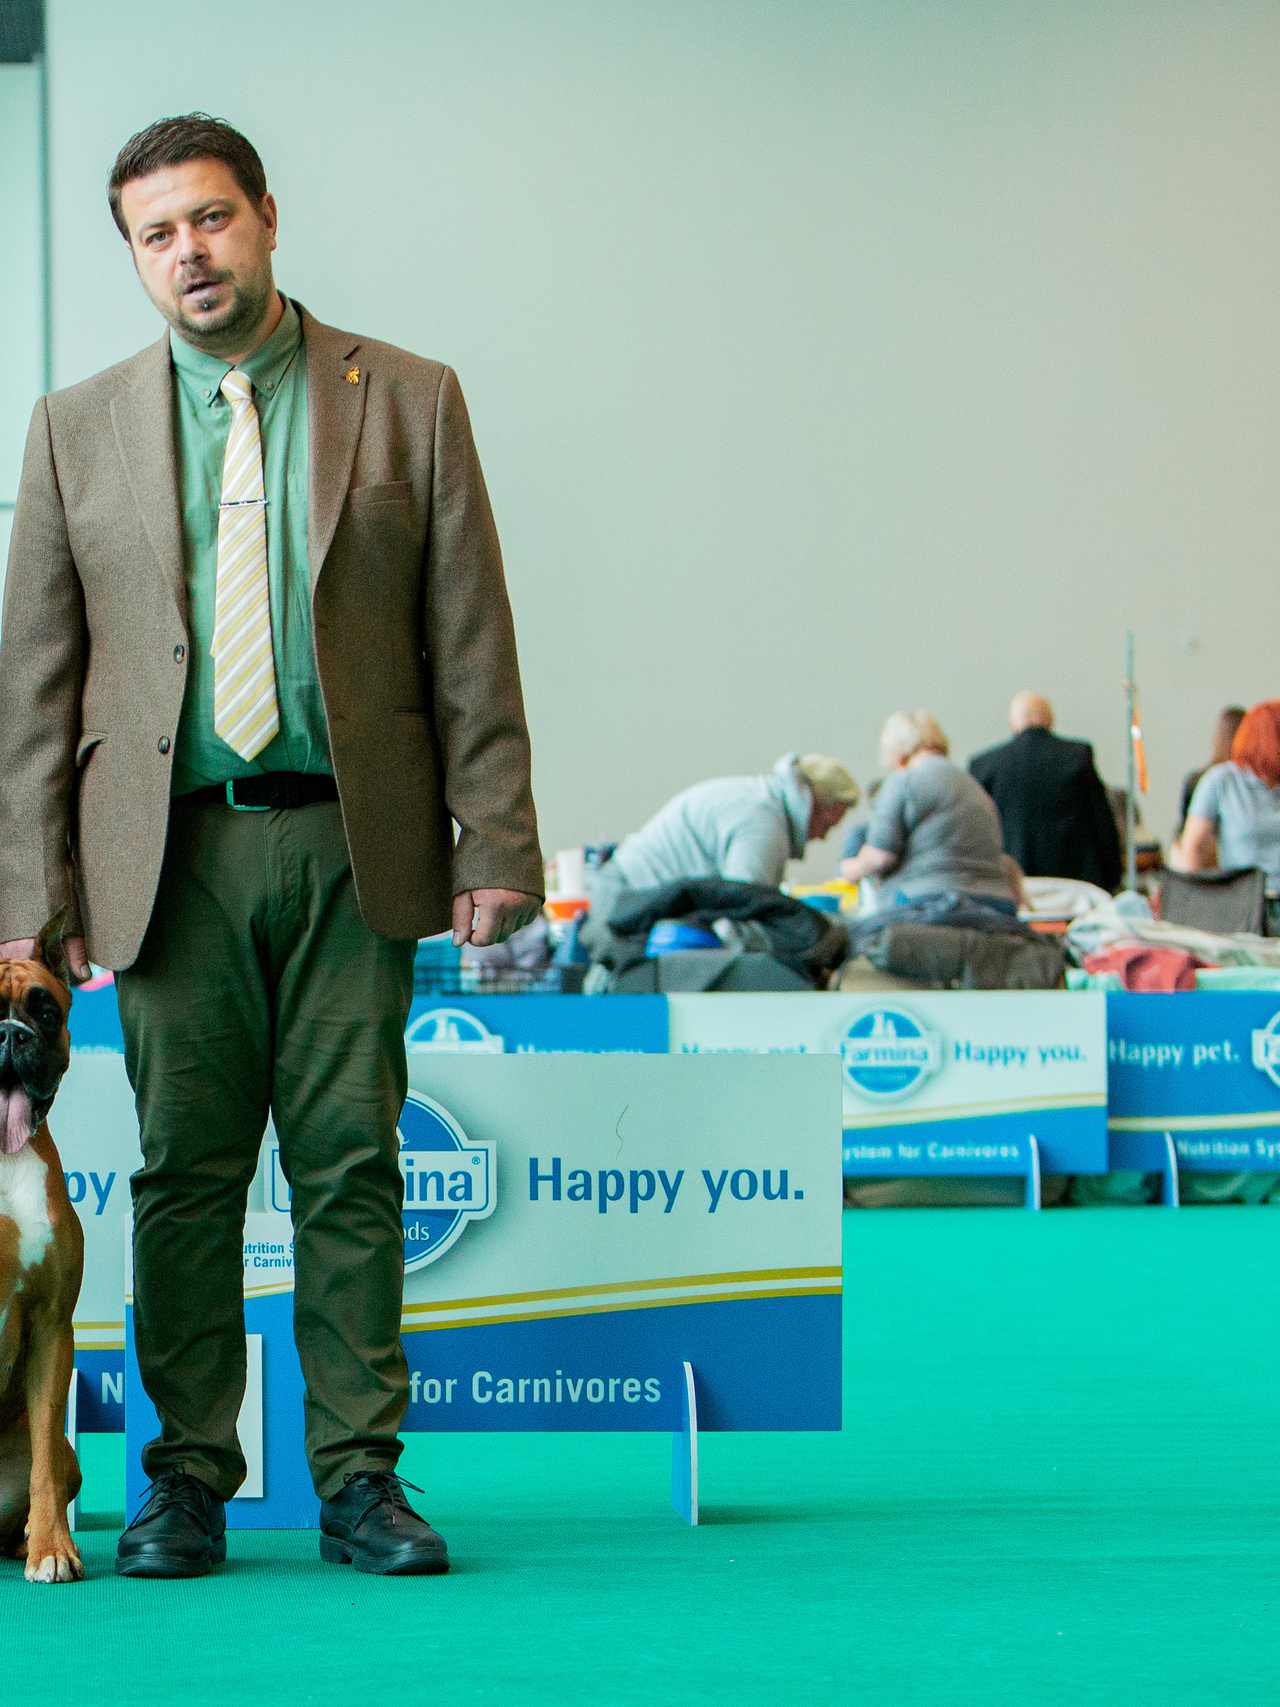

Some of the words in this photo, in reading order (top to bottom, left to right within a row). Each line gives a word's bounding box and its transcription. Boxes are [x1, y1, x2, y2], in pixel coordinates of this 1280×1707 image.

[954, 1041, 1028, 1066] Happy
[1109, 1039, 1183, 1068] Happy
[529, 1157, 685, 1214] Happy
[701, 1169, 804, 1213] you.
[243, 1242, 284, 1254] utrition
[253, 1256, 293, 1268] Carniv
[409, 1371, 458, 1403] for
[472, 1370, 662, 1404] Carnivores
